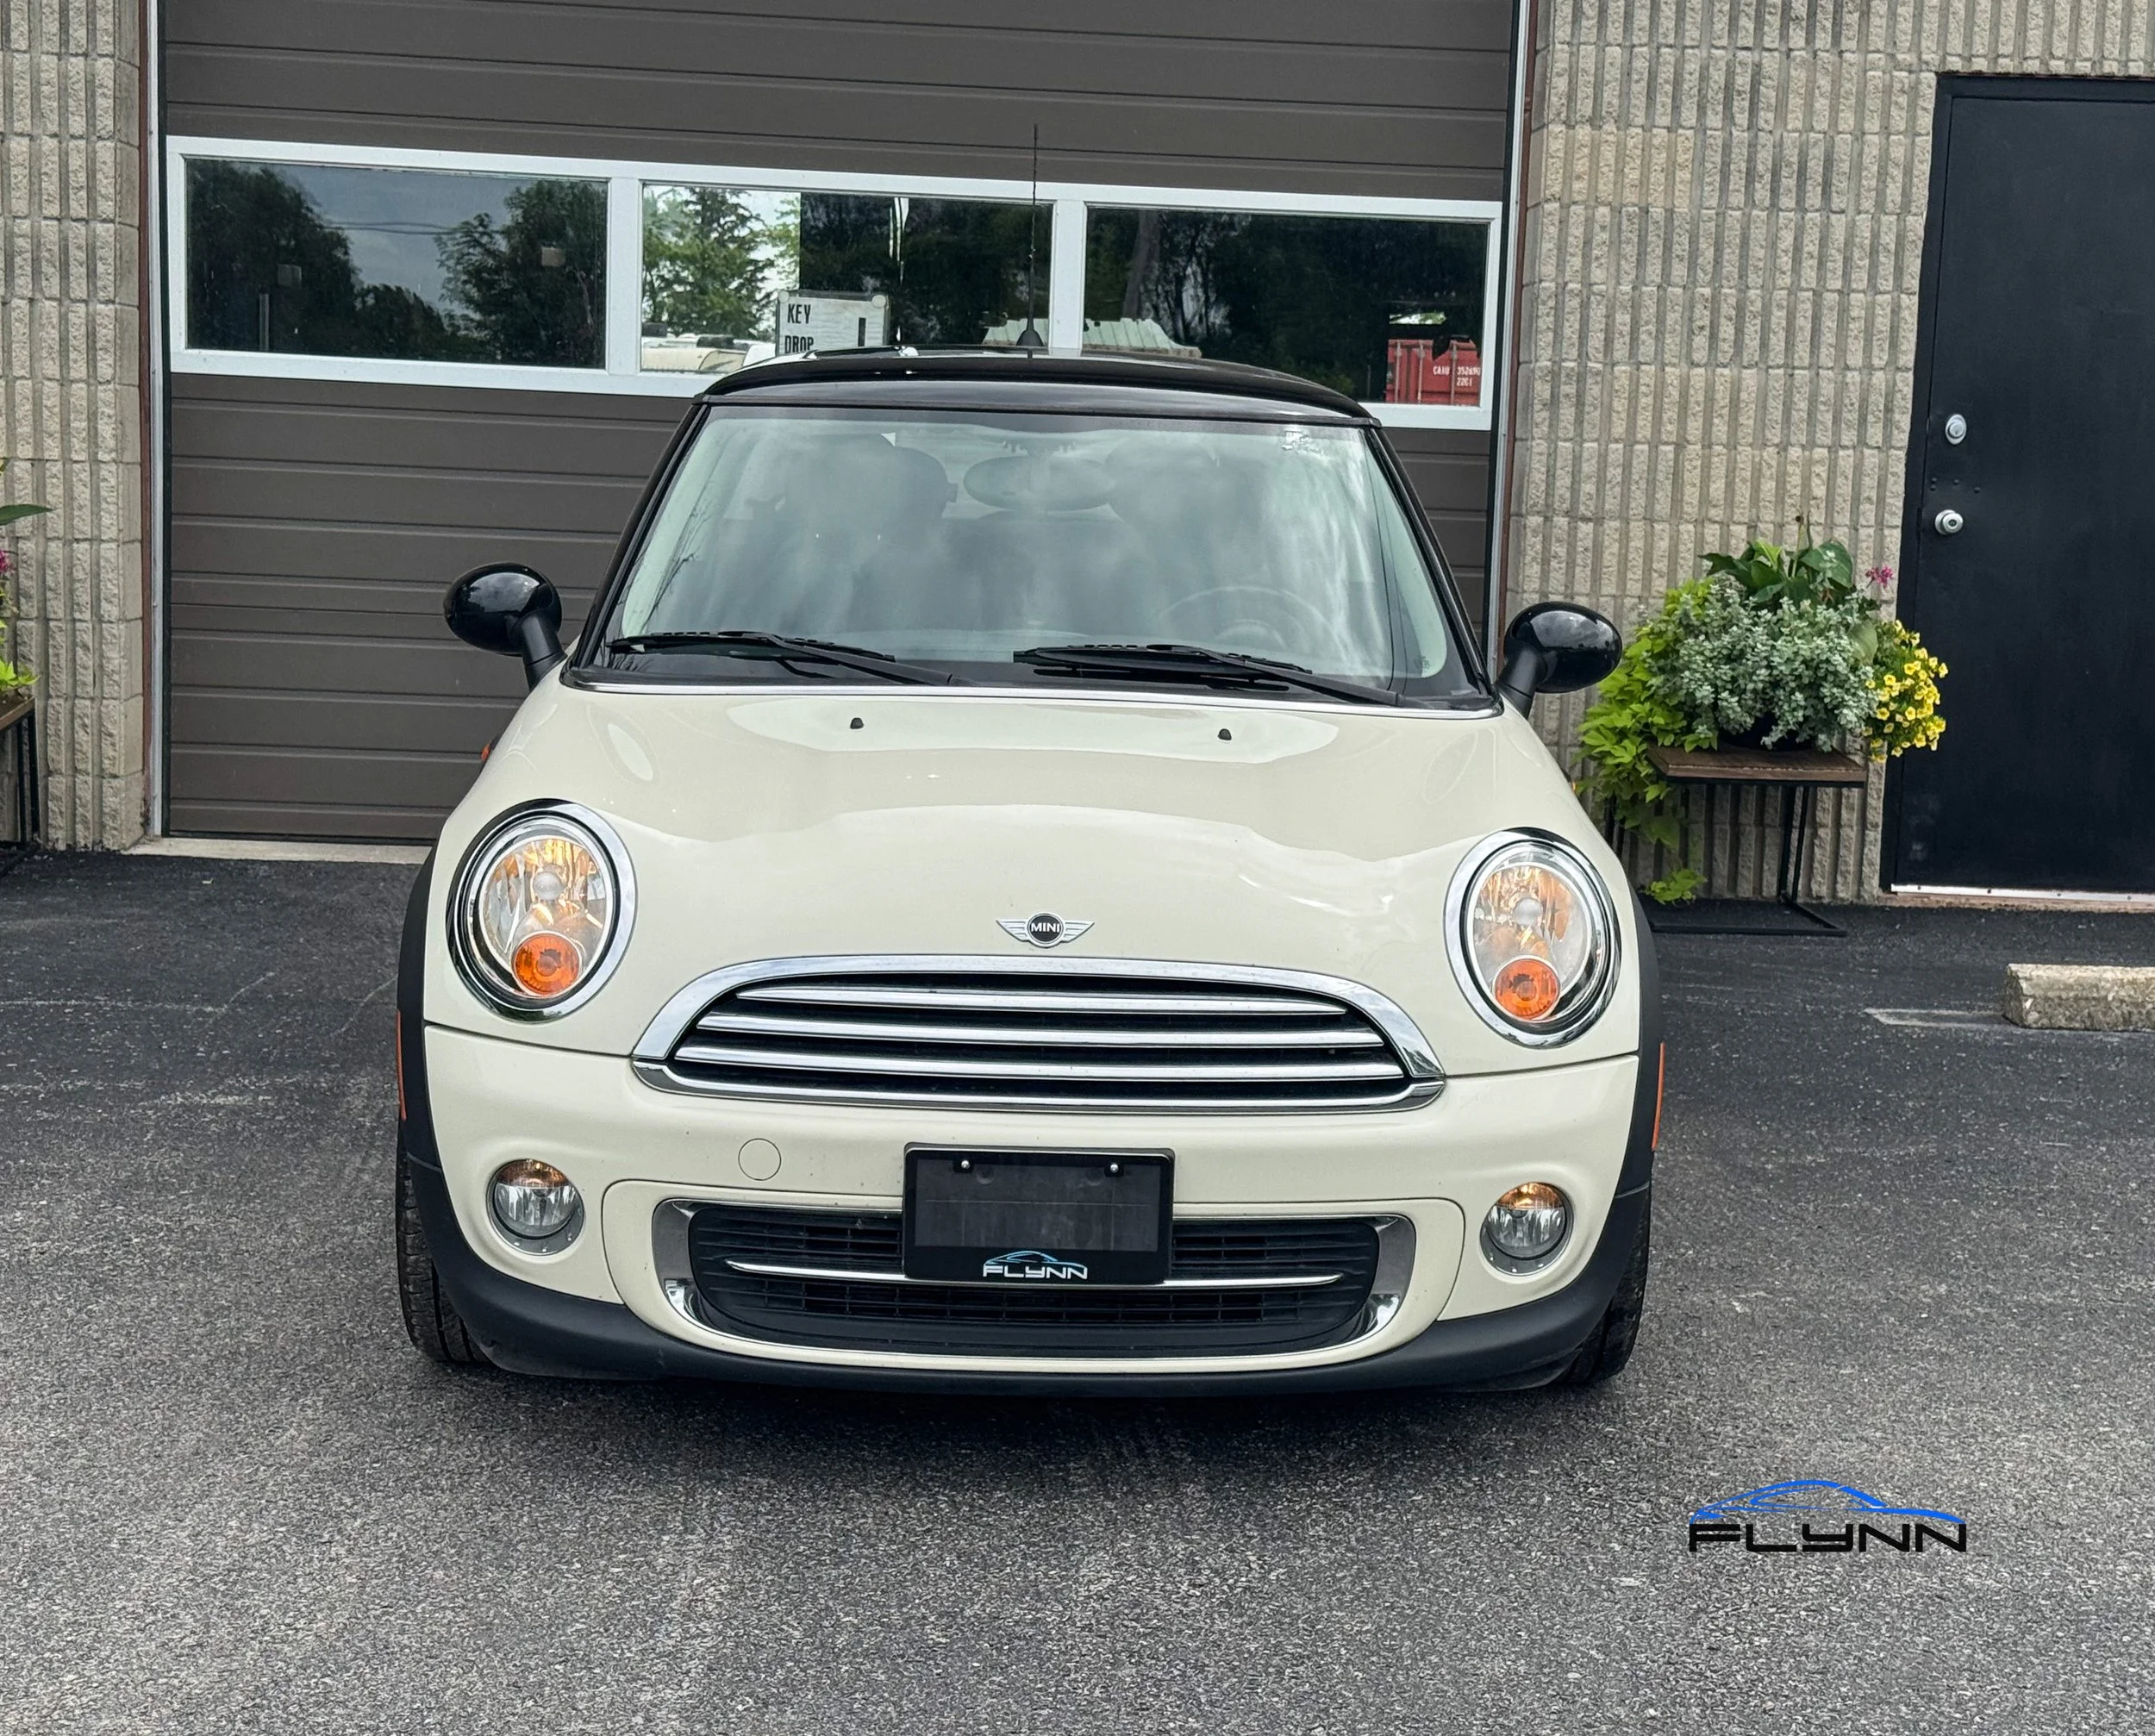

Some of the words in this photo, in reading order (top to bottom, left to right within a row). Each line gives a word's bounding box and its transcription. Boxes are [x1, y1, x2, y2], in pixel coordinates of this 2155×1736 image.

[787, 303, 811, 324] KEY
[784, 335, 815, 353] DROP
[1030, 921, 1060, 934] MINI
[983, 1265, 1088, 1280] FLYNN
